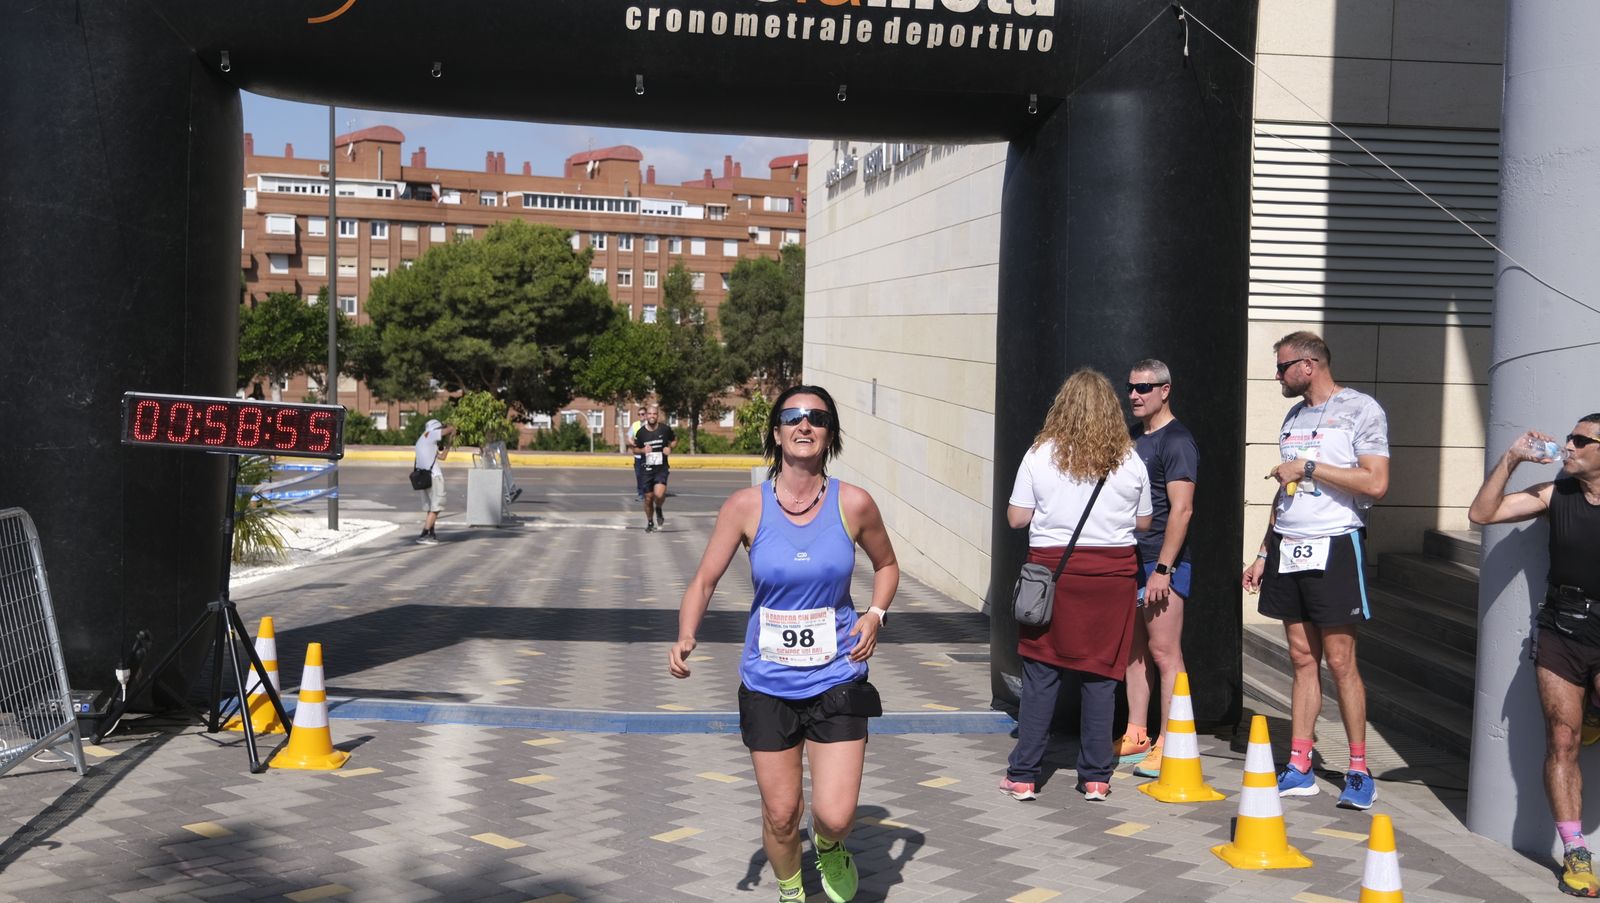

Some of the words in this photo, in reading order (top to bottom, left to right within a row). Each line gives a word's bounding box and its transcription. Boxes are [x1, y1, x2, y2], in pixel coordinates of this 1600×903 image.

[625, 6, 873, 45] cronometraje
[883, 16, 1054, 53] deportivo
[133, 400, 331, 451] 00:58:55
[1293, 545, 1313, 558] 63
[782, 628, 815, 648] 98
